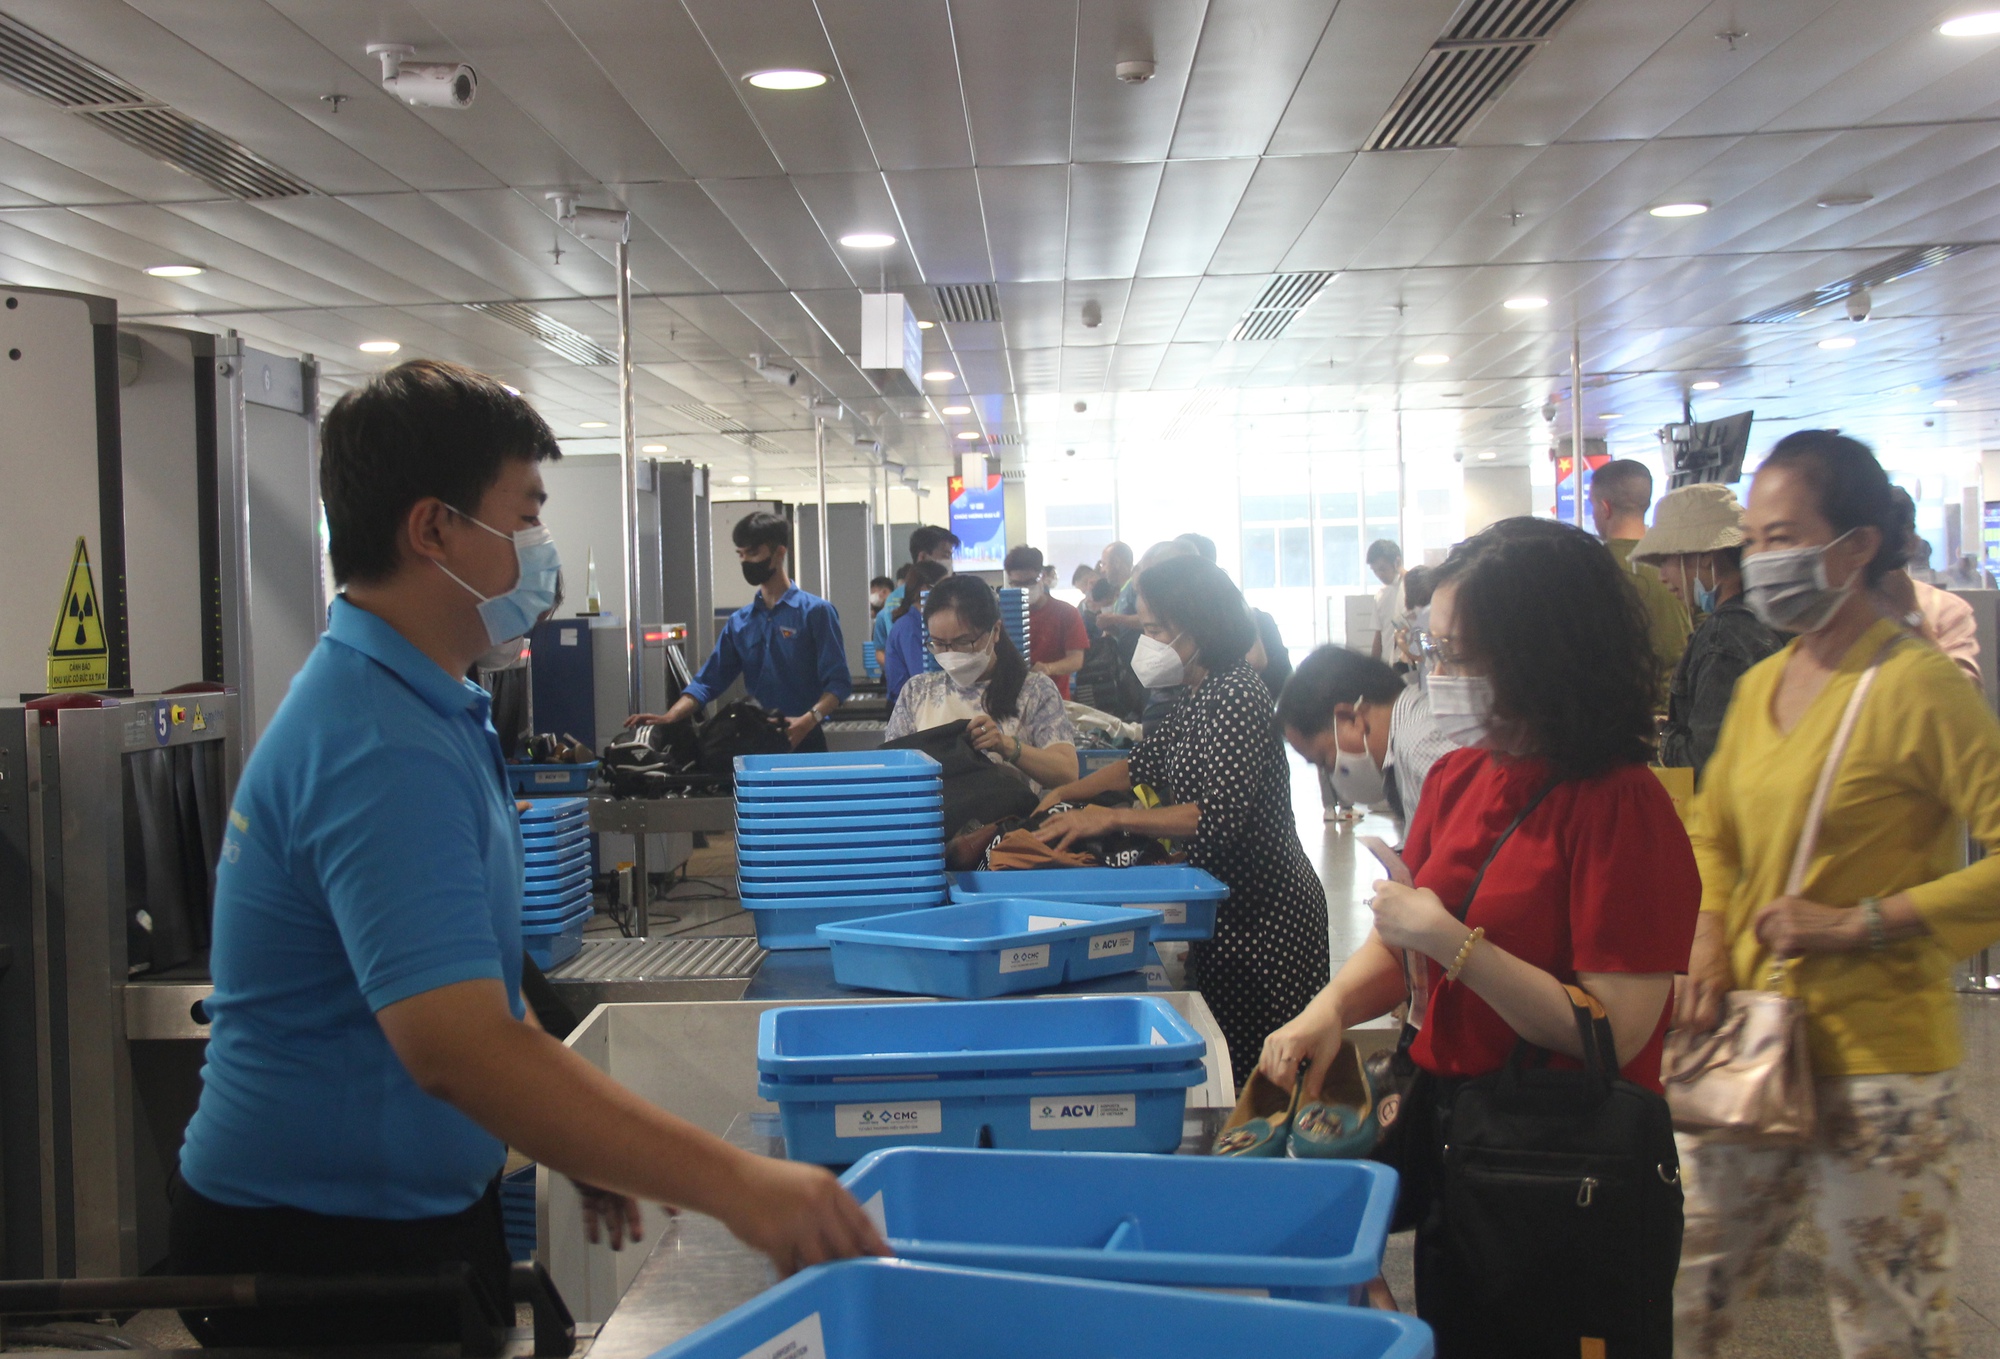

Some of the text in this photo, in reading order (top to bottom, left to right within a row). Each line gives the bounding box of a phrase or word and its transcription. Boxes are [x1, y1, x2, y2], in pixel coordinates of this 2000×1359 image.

[159, 708, 167, 736] 5
[1102, 939, 1117, 949] ACV
[893, 1111, 918, 1120] CMC
[1060, 1105, 1095, 1117] ACV
